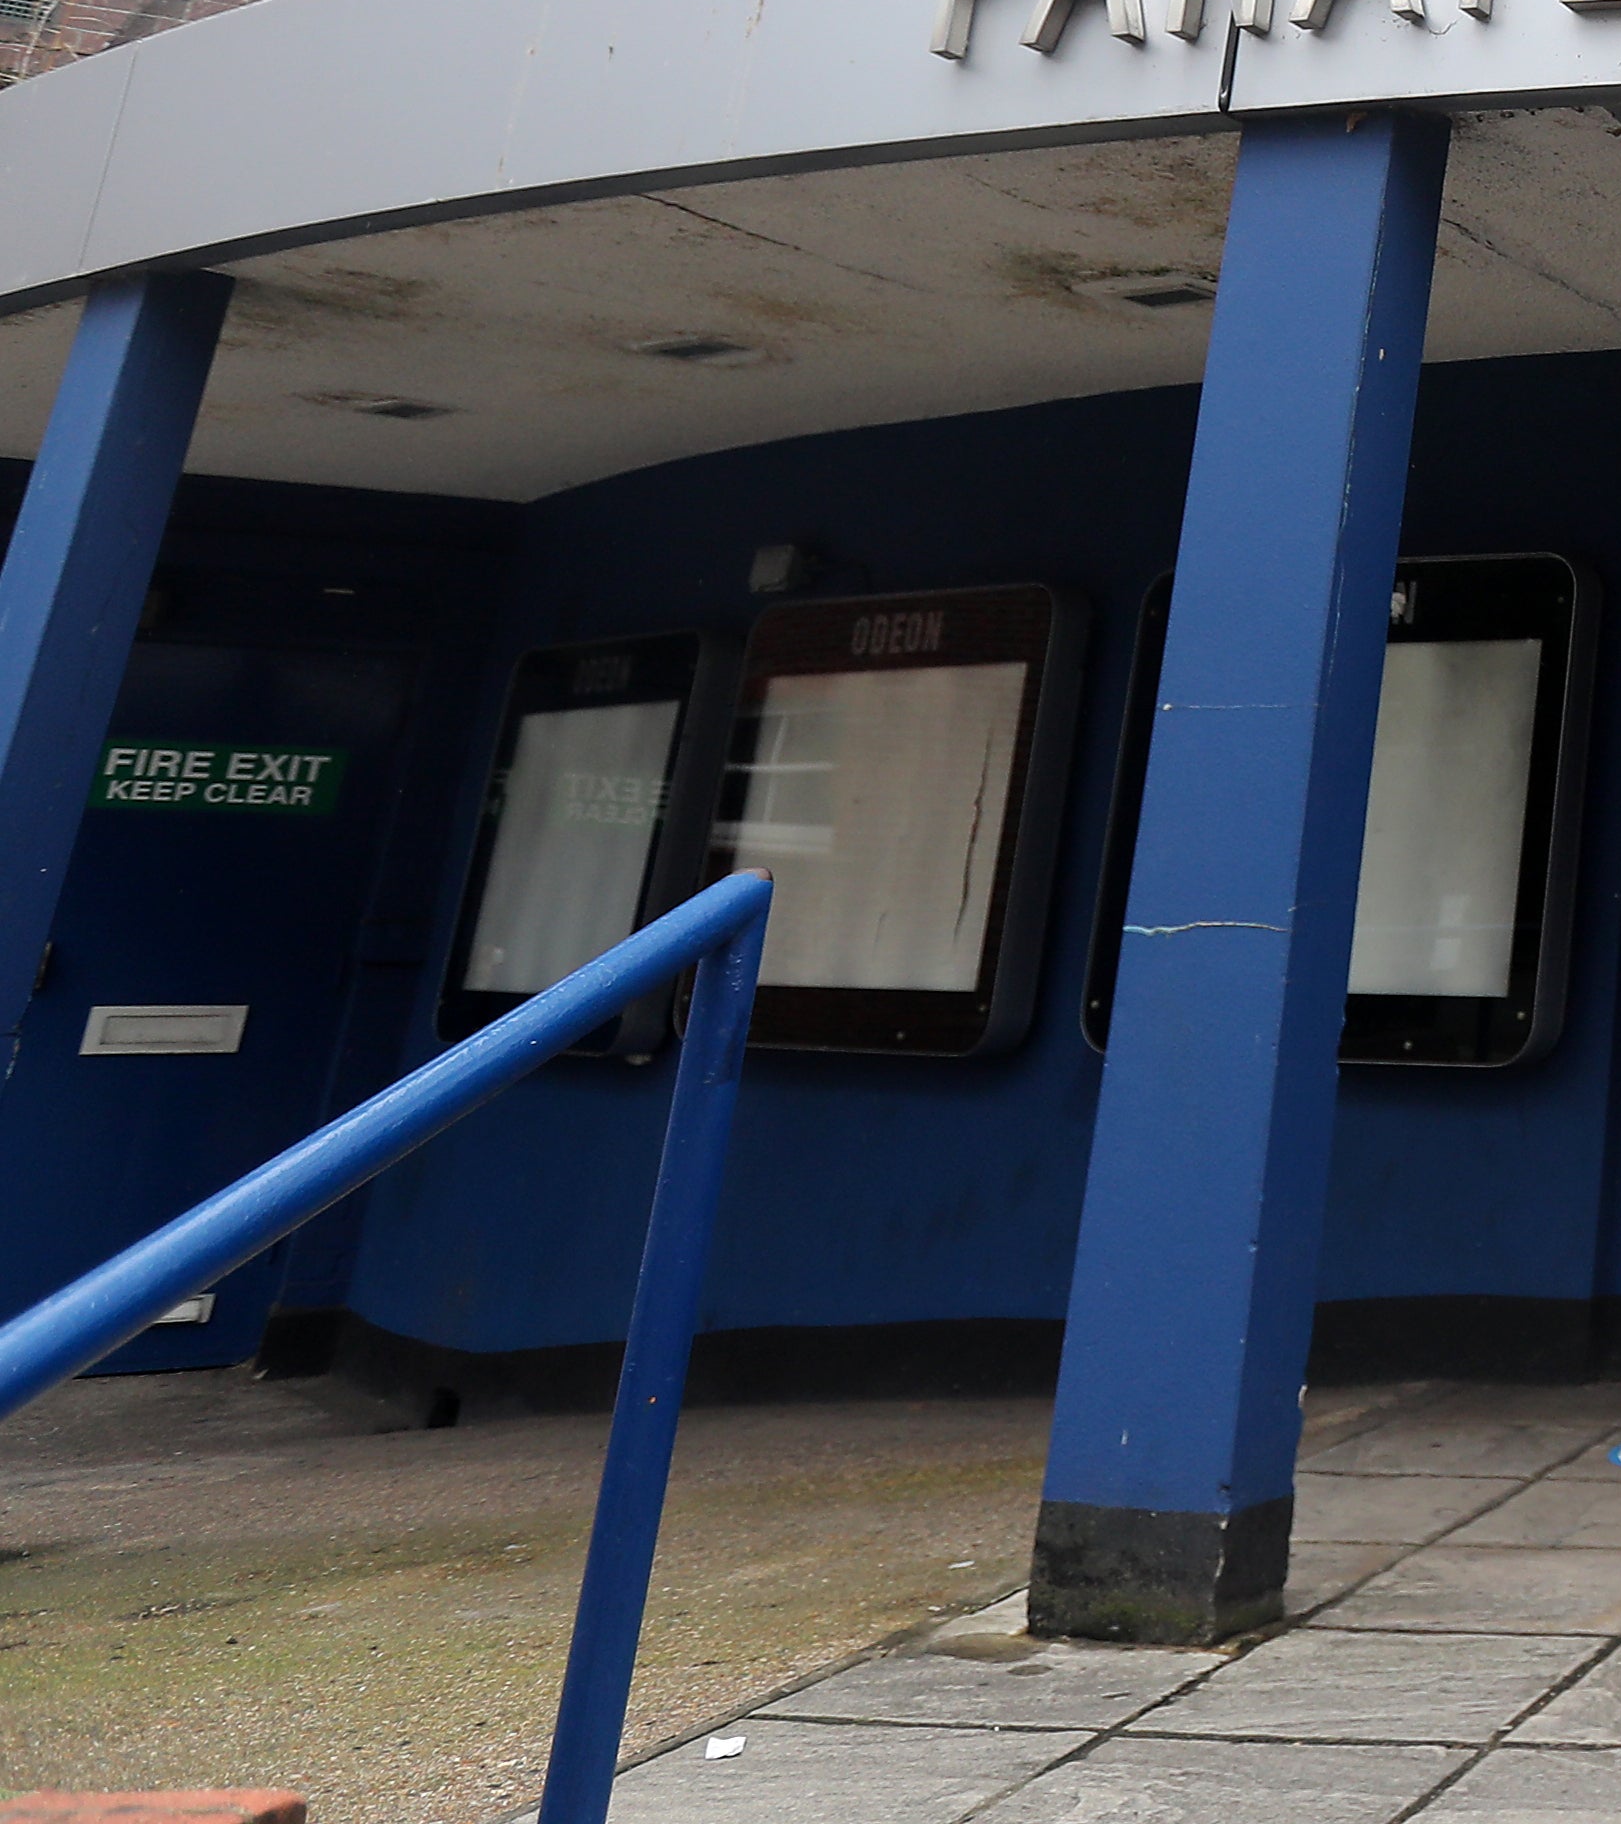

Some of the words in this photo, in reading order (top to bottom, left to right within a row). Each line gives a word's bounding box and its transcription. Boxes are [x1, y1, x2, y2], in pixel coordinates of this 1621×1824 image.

[851, 610, 945, 656] ODEON
[103, 747, 217, 780] FIRE
[225, 751, 333, 783] EXIT
[105, 779, 198, 802] KEEP
[203, 782, 314, 806] CLEAR
